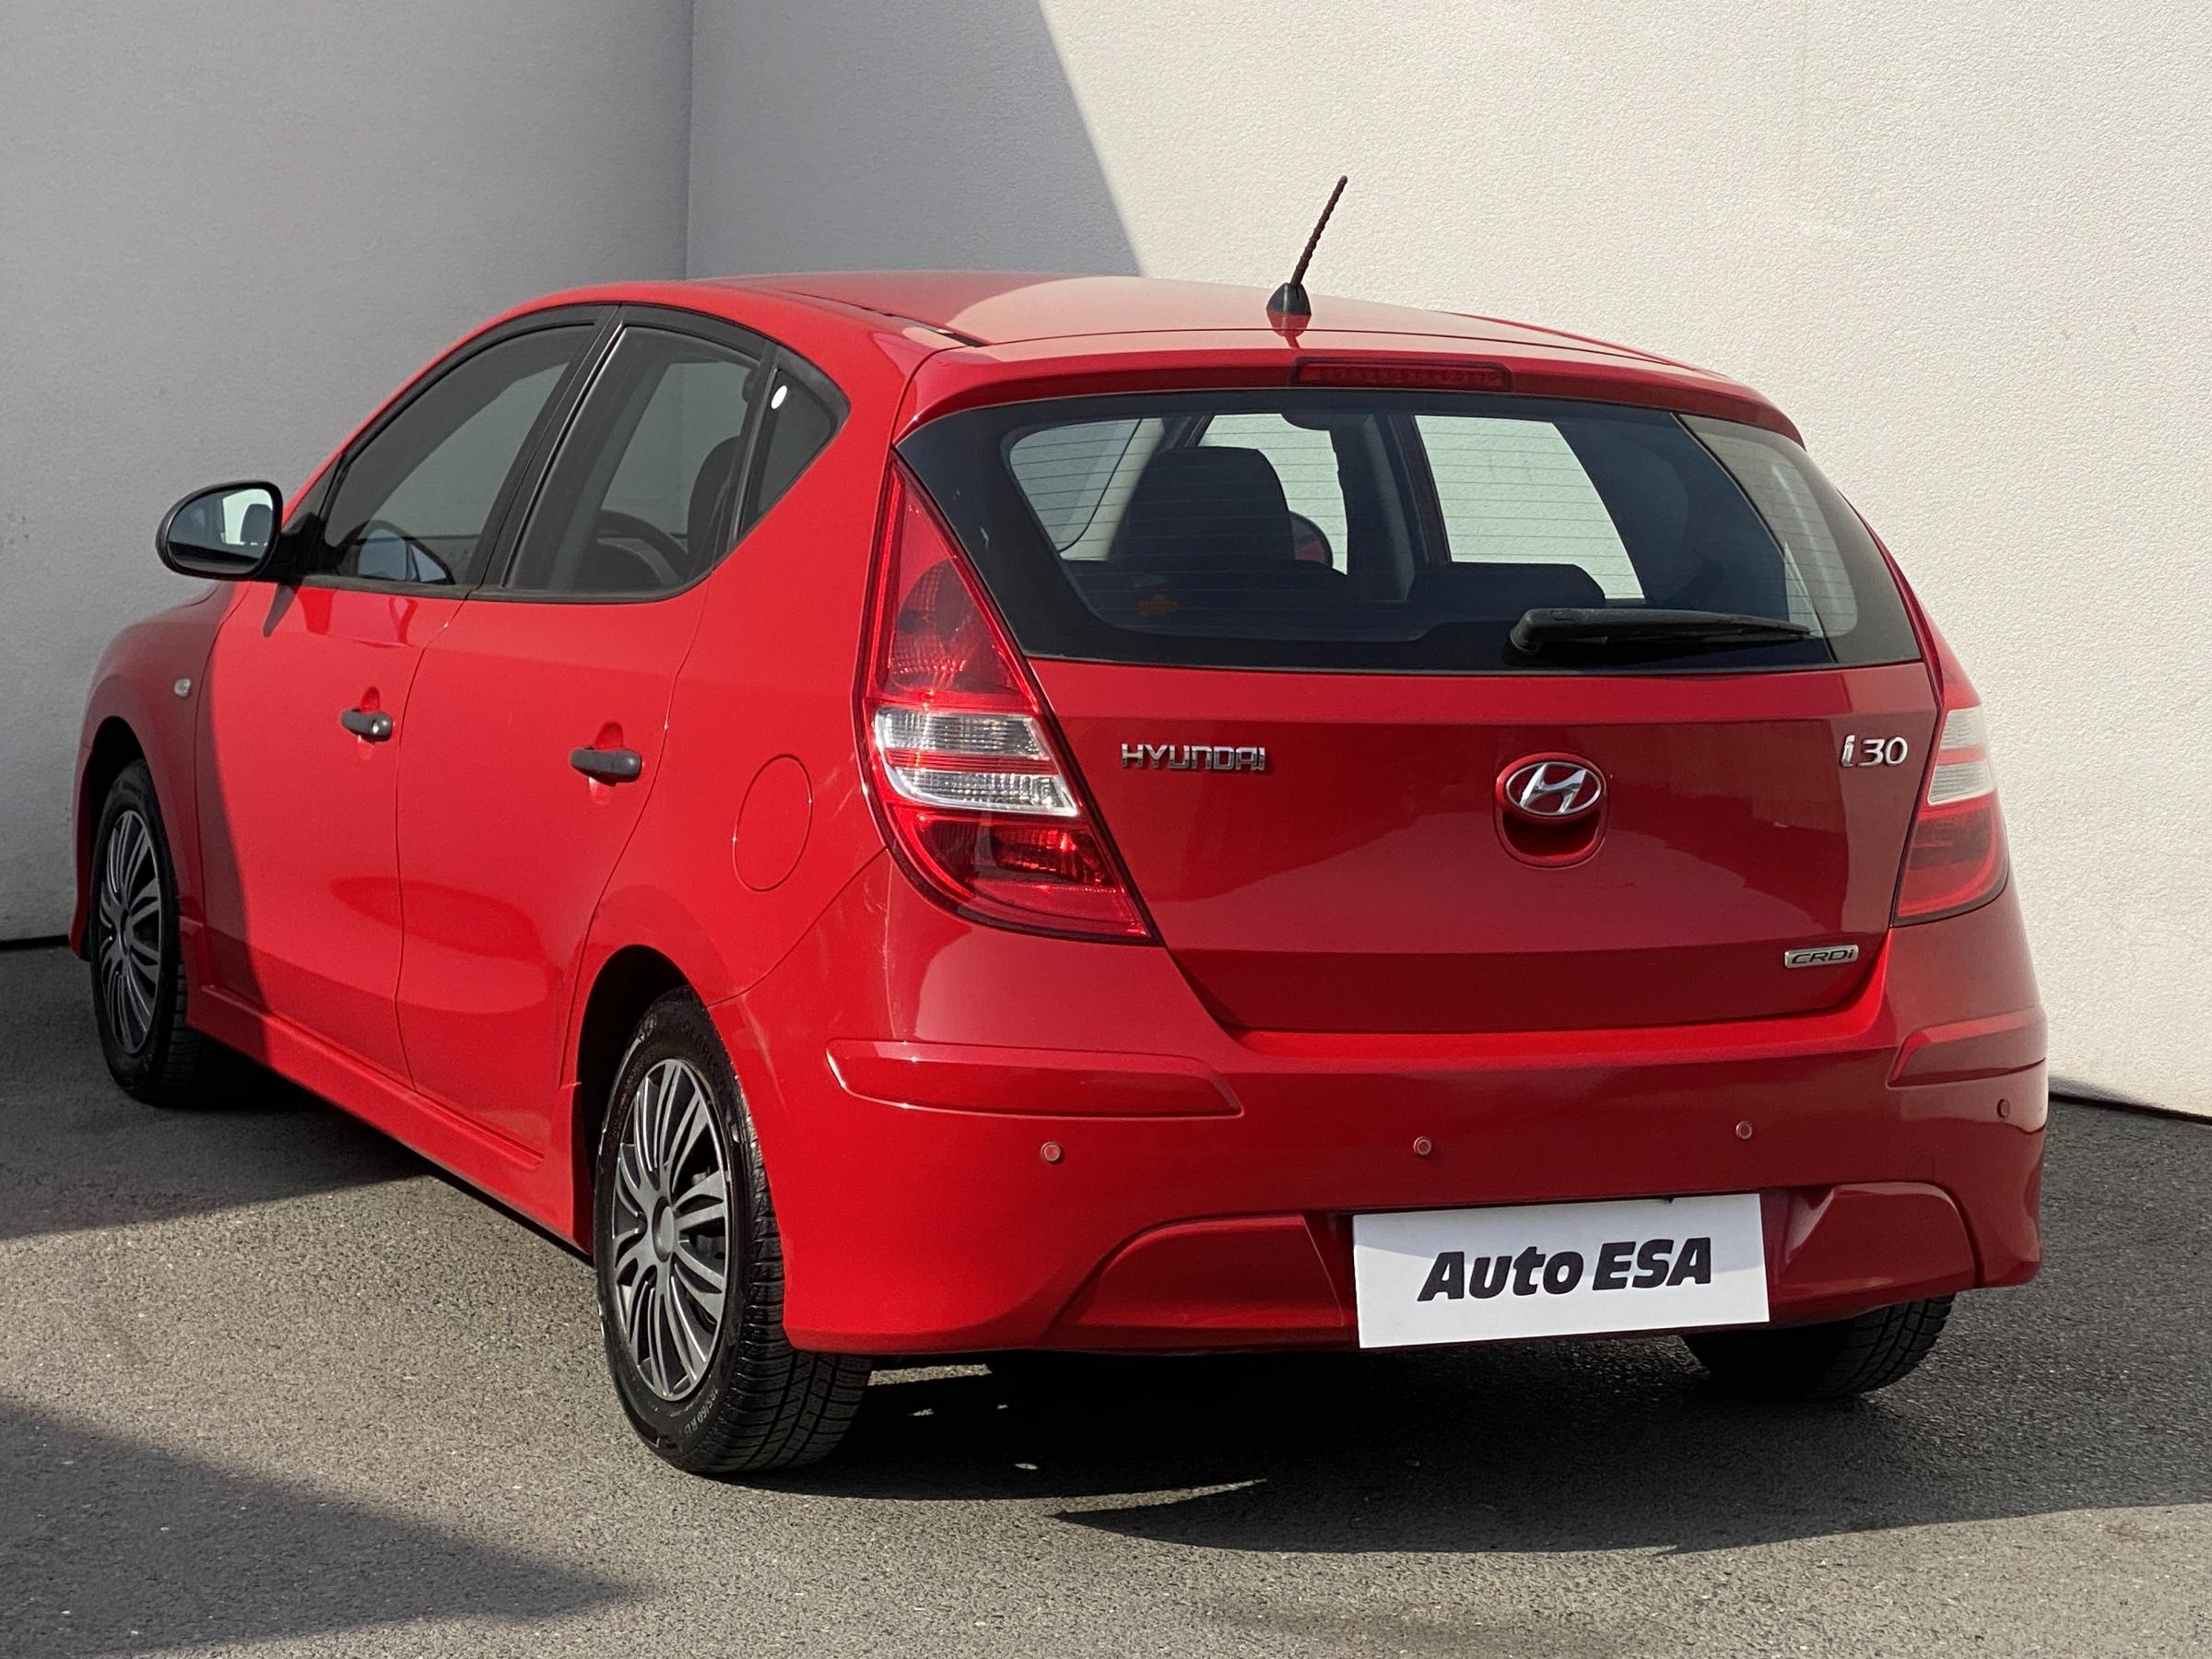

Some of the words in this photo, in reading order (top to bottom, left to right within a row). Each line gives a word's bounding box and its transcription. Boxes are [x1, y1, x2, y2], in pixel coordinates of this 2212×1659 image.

[1121, 743, 1266, 771] HYUNDAI
[1841, 735, 1909, 768] i30
[1791, 948, 1855, 965] CRDi
[1417, 1245, 1584, 1302] Auto
[1592, 1236, 1712, 1291] ESA
